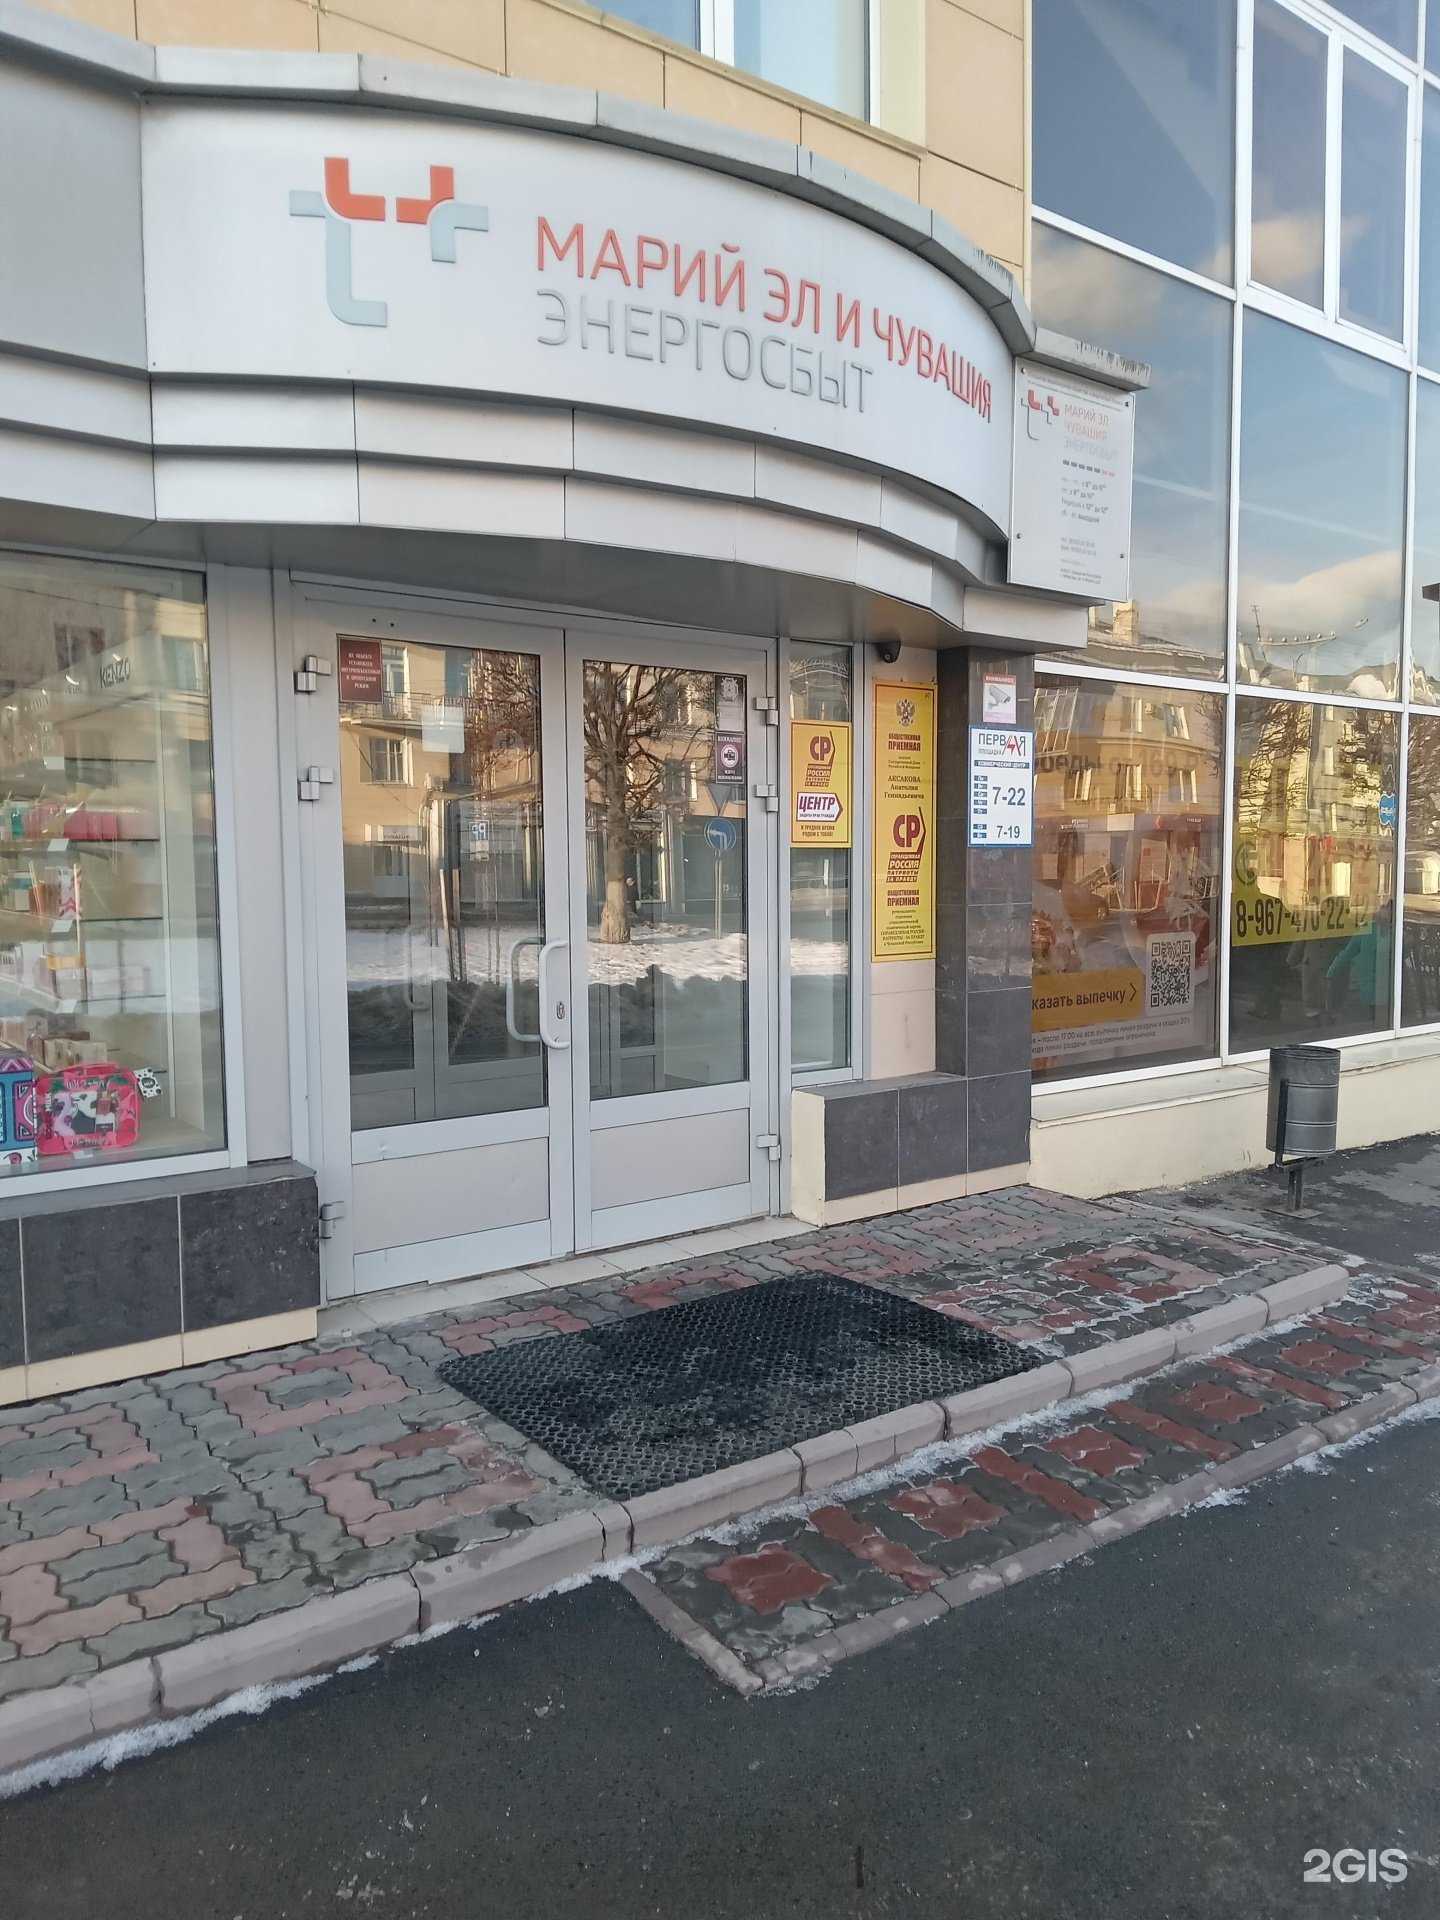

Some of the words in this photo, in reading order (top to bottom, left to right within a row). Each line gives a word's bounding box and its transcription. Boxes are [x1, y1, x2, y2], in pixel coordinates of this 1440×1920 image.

[537, 215, 746, 313] МАРИЙ
[763, 267, 822, 334] ЭЛ
[835, 292, 862, 349] И
[873, 306, 992, 424] ЧУВАШИЯ
[536, 288, 874, 414] ЭНЕРГОСБЫТ
[100, 656, 130, 689] KENZO
[810, 736, 831, 760] СР
[888, 741, 921, 751] ПРИЕМНАЯ
[799, 796, 836, 812] ЦЕНТР
[992, 786, 1026, 806] 7-22
[893, 815, 921, 848] СР
[996, 825, 1021, 839] 7-19
[889, 860, 920, 869] РОССИЯ
[887, 897, 920, 907] ПРИЕМНАЯ
[1076, 988, 1126, 1006] выпечку
